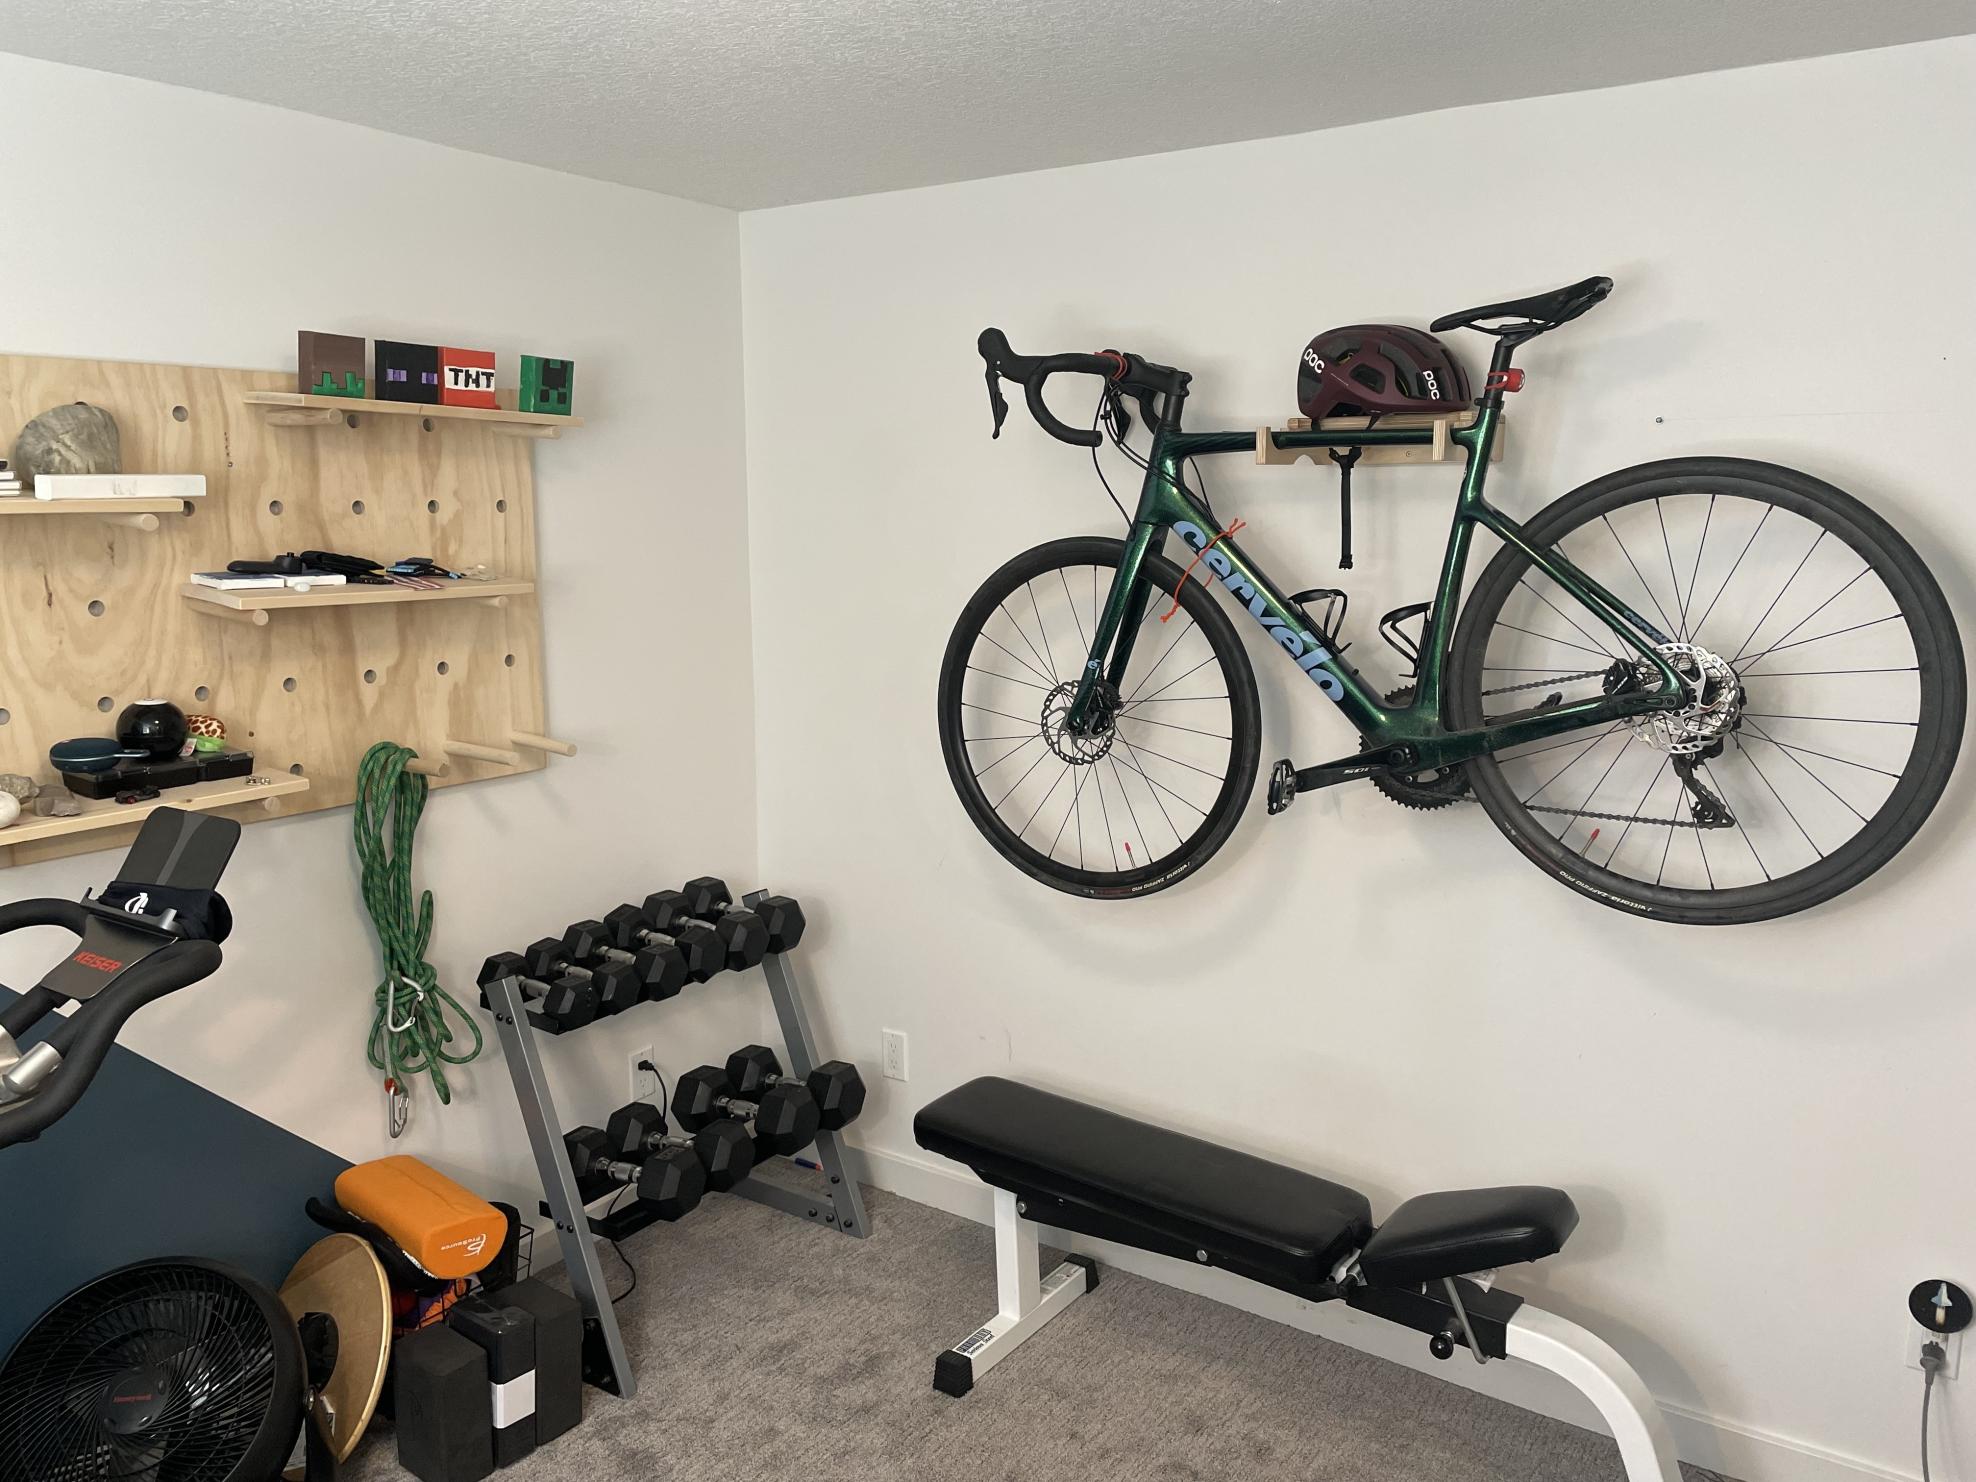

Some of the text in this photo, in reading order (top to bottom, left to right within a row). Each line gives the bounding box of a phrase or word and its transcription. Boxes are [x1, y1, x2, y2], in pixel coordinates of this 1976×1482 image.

[448, 367, 495, 389] TNT
[1559, 870, 1576, 882] PRO
[1575, 880, 1608, 897] ZAFFIRO
[73, 951, 122, 973] KEISER
